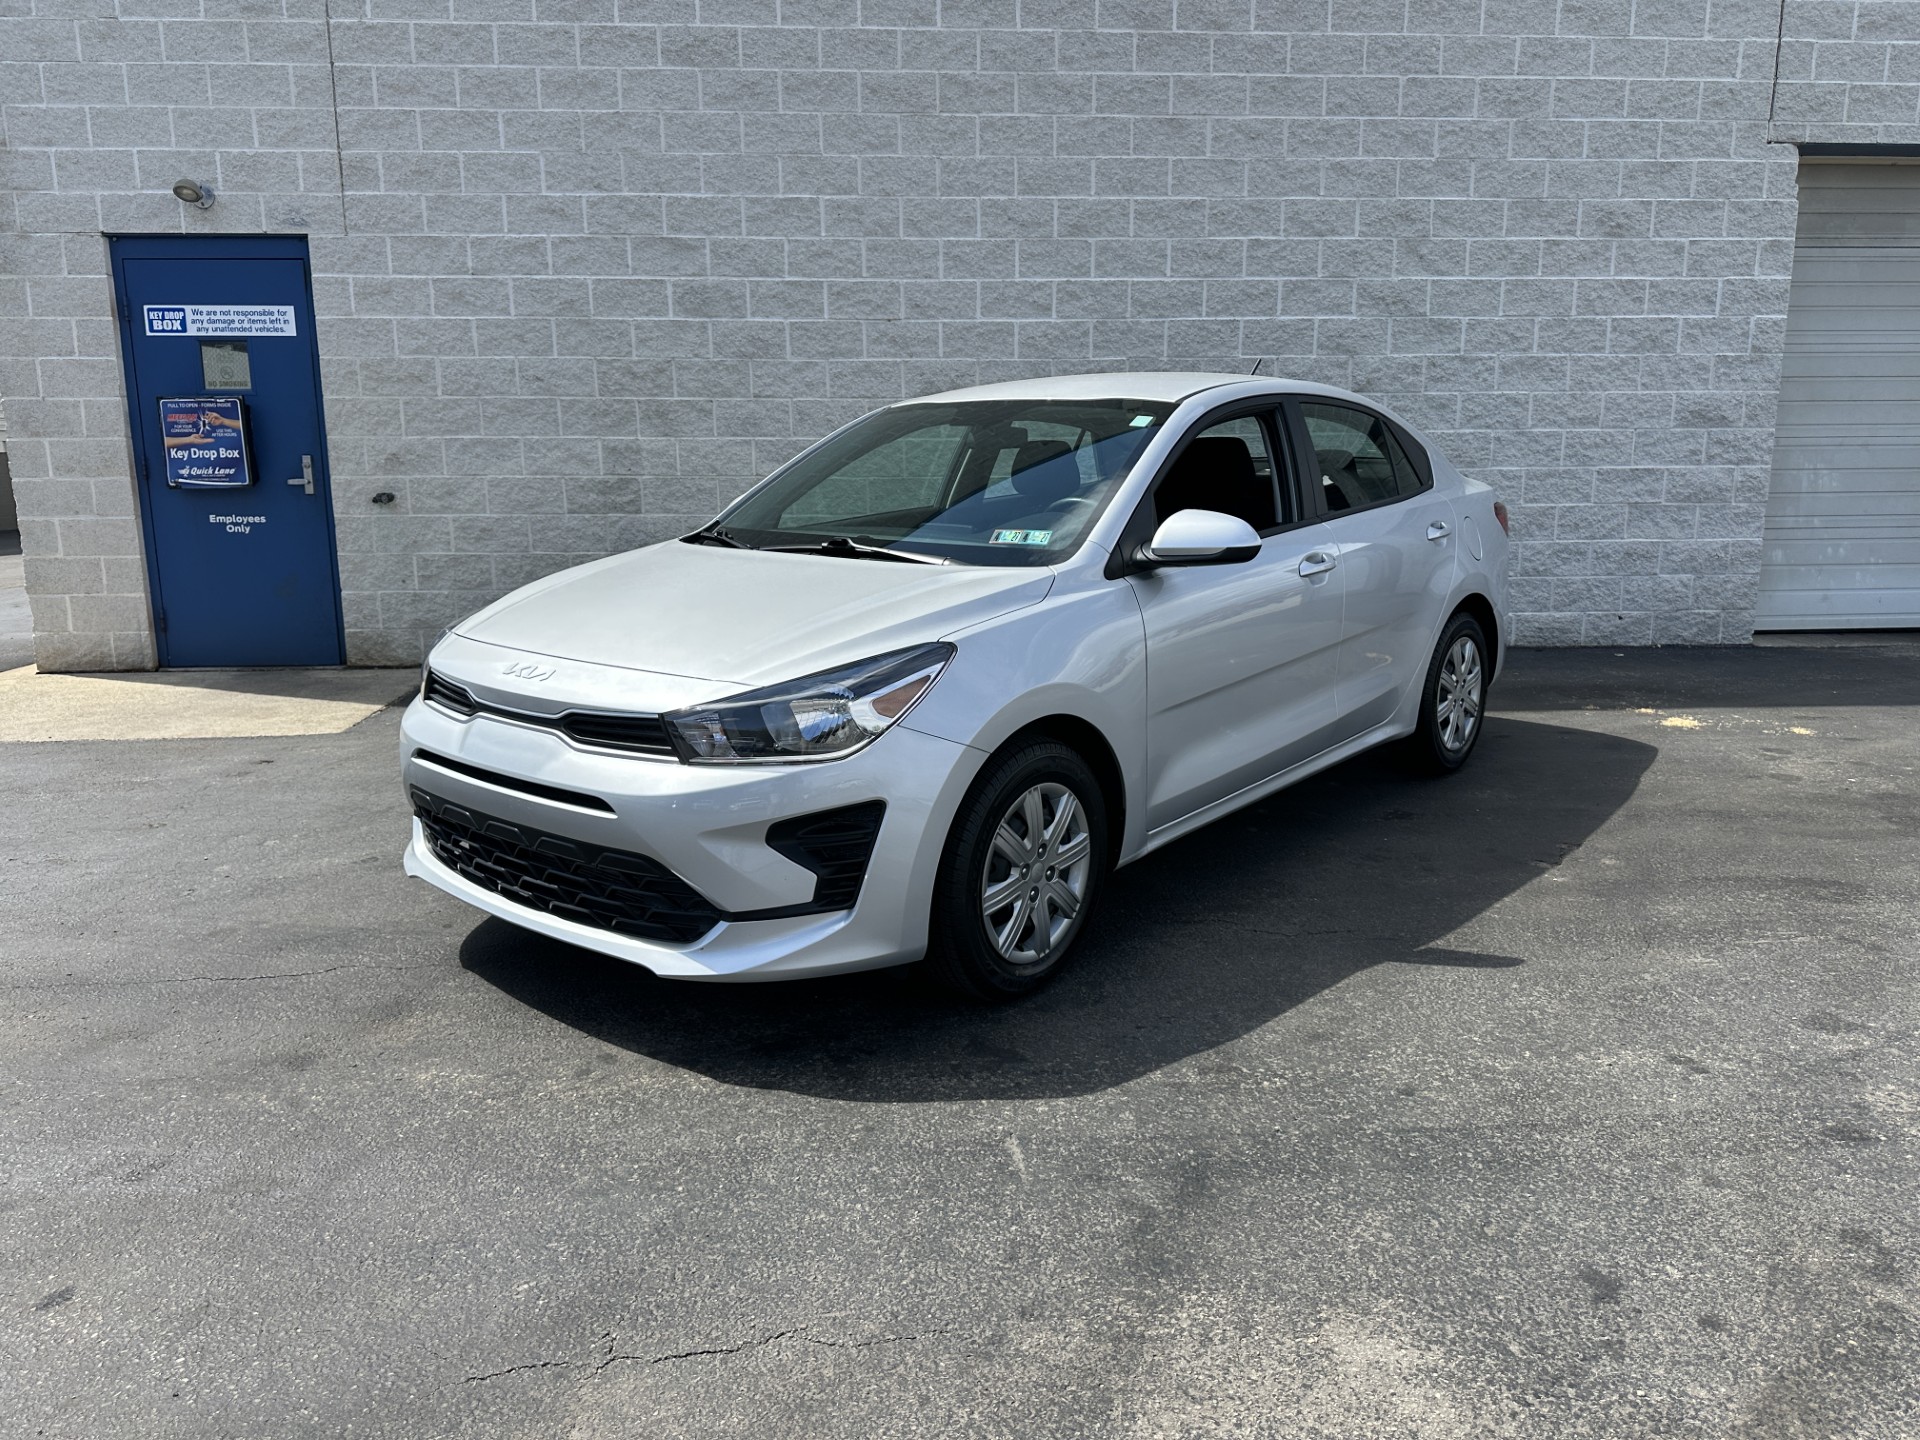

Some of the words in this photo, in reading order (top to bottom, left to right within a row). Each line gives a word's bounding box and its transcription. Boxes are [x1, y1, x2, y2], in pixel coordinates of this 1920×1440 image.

[149, 311, 163, 320] KEY
[164, 311, 185, 320] DROP
[233, 309, 275, 317] responsible
[152, 320, 182, 330] BOX
[191, 318, 204, 326] any
[206, 317, 235, 326] damage
[247, 317, 267, 325] items
[269, 317, 281, 325] left
[283, 317, 290, 325] in
[196, 326, 209, 334] any
[212, 325, 252, 333] unattended
[255, 325, 286, 333] vehicles.
[170, 448, 189, 461] Key
[191, 448, 217, 460] Drop
[219, 447, 240, 458] Box
[190, 466, 214, 475] Quick
[214, 467, 236, 475] Lane
[209, 514, 266, 524] Employees
[226, 524, 250, 534] Only
